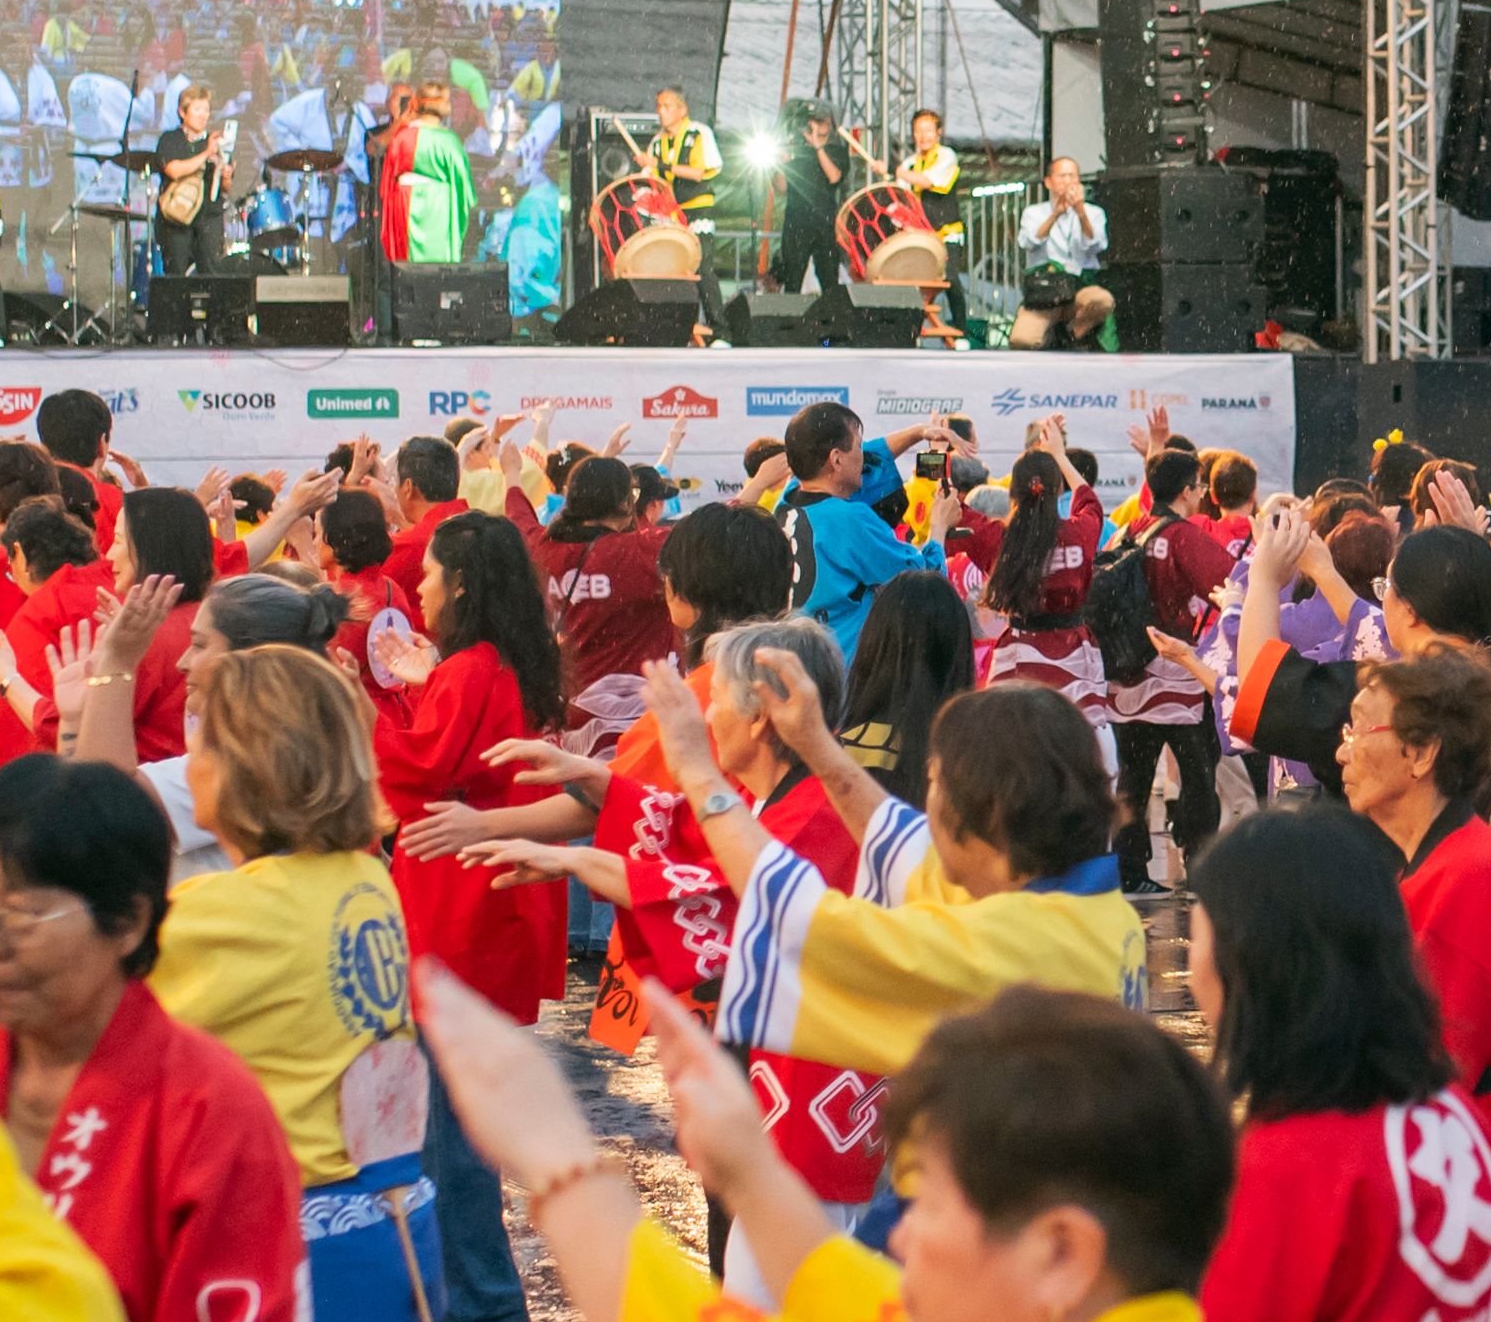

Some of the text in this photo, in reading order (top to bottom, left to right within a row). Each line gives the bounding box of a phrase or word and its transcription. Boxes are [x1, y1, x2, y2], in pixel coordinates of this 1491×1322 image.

[202, 393, 276, 410] SICOOB
[315, 396, 372, 411] Unimed
[428, 390, 492, 416] RPC
[650, 398, 709, 417] Sakura
[876, 397, 963, 415] MIDIOGRAF
[1028, 394, 1118, 409] SANEPAR
[1201, 396, 1257, 409] PARANÁ
